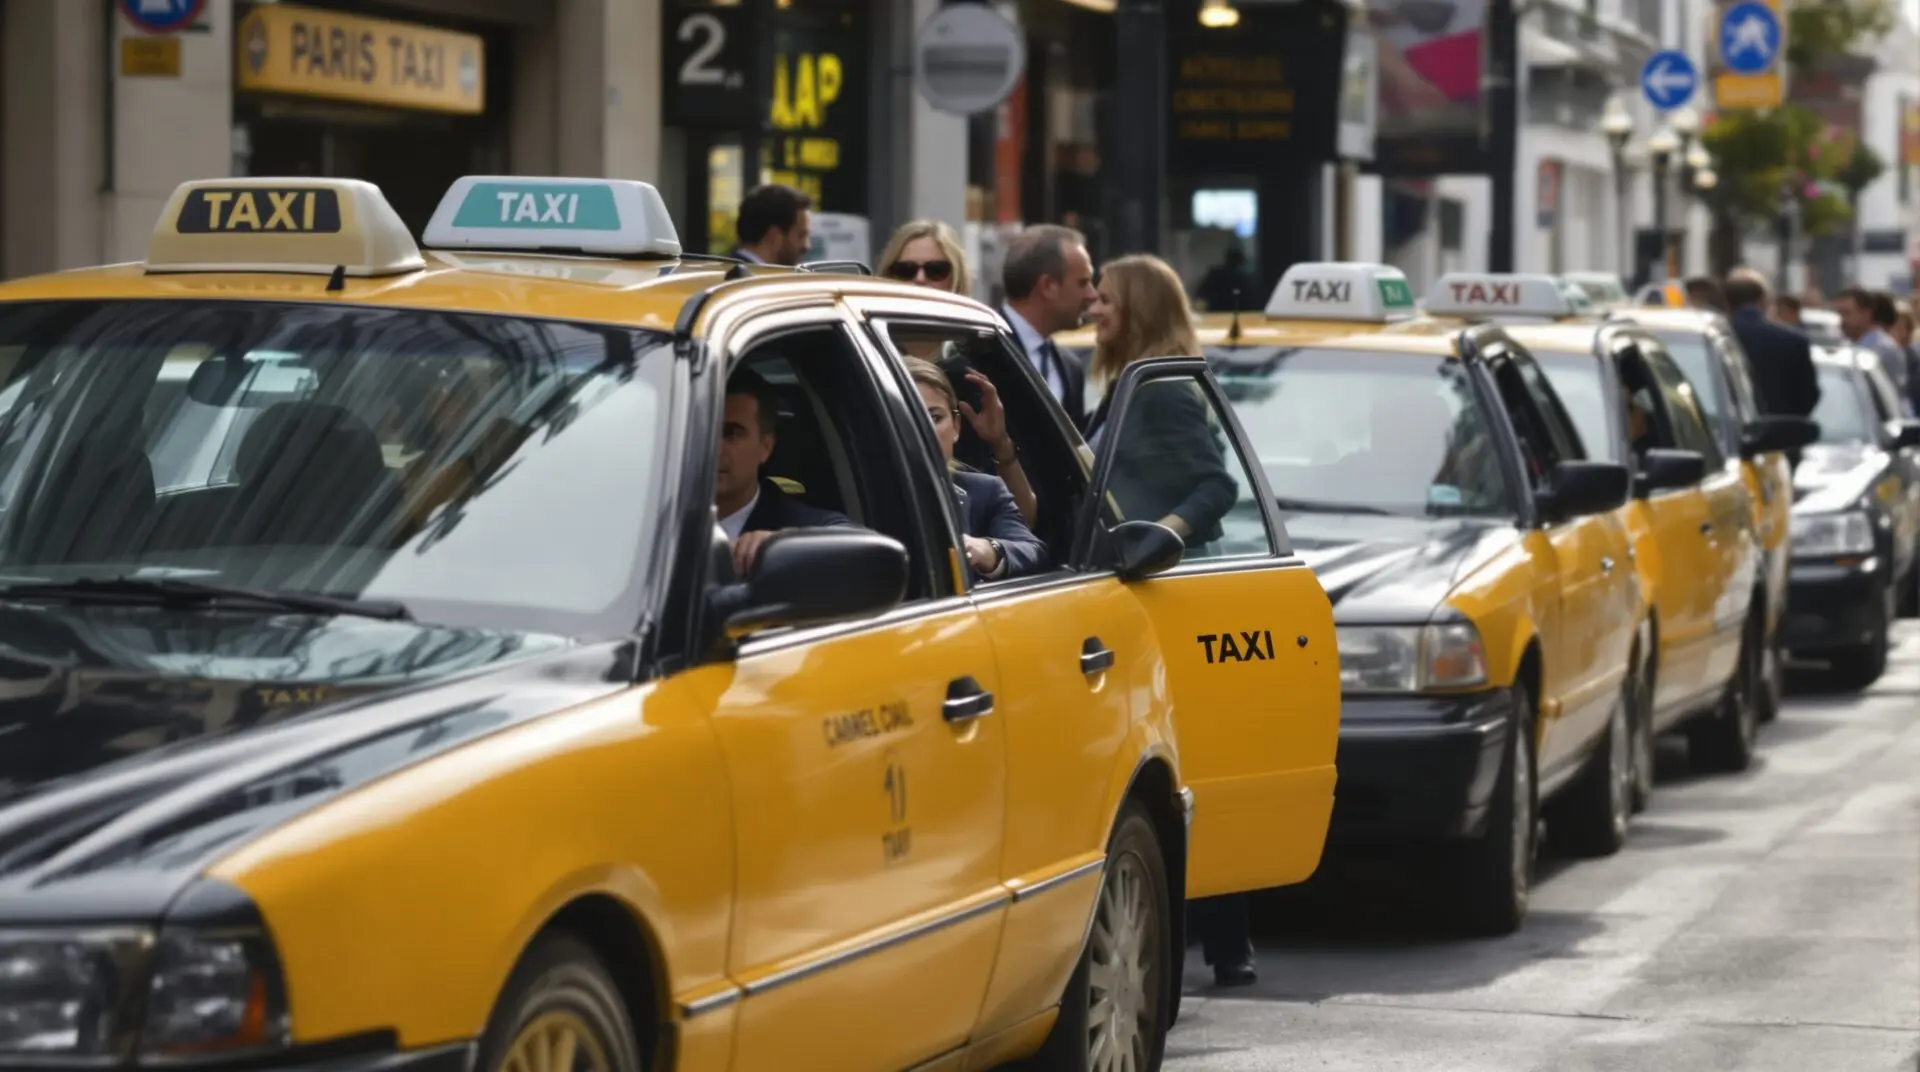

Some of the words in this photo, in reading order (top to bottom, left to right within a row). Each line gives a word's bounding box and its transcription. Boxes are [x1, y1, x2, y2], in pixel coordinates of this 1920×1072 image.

[291, 21, 377, 84] PARIS
[388, 37, 447, 90] TAXI
[677, 13, 725, 85] 2
[204, 191, 316, 230] TAXI
[496, 192, 578, 224] TAXI
[1292, 279, 1350, 302] TAXI
[1450, 282, 1518, 305] TAXI
[1197, 630, 1275, 664] TAXI
